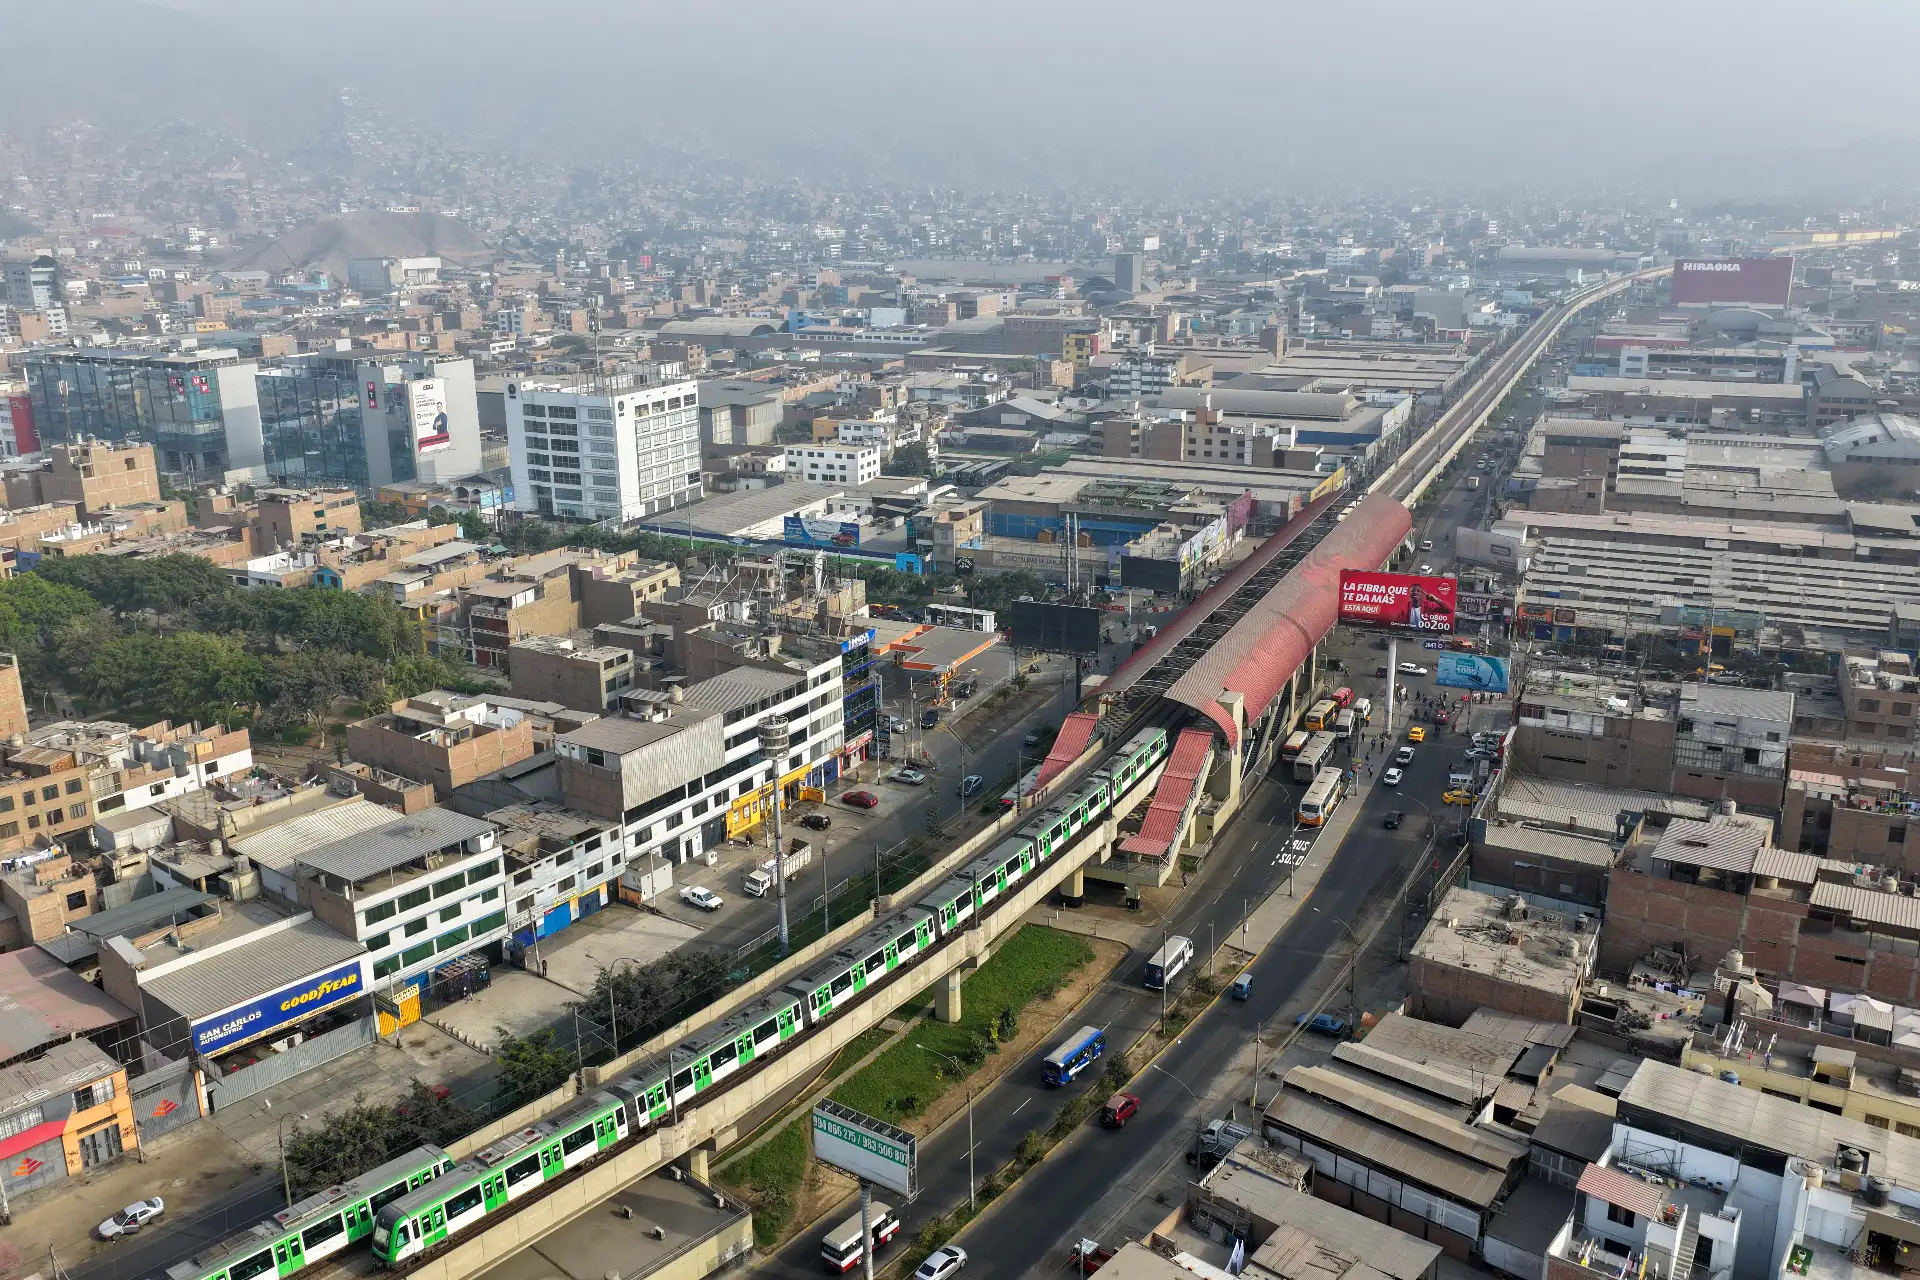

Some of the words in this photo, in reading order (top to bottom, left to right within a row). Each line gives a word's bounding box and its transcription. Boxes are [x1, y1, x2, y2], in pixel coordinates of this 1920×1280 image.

[1682, 262, 1741, 272] HIRAOKA
[1343, 582, 1356, 591] LA
[1357, 583, 1386, 594] FIBRA
[1387, 586, 1408, 596] QUE
[1343, 592, 1354, 601] TE
[1356, 594, 1370, 602] DA
[1371, 594, 1395, 605] MÁS
[1344, 603, 1361, 612] ESTÁ
[1360, 604, 1379, 613] AQUÍ
[1418, 620, 1451, 631] 00200
[1290, 839, 1310, 851] BUS
[280, 974, 357, 1012] GOODYEAR
[199, 1028, 221, 1041] SAN
[222, 1011, 262, 1033] CARLOS
[200, 1024, 244, 1046] AUTOMOTRIZ
[813, 1115, 827, 1131] 994
[827, 1123, 842, 1137] 066
[843, 1129, 856, 1143] 275
[862, 1136, 877, 1152] 983
[878, 1143, 893, 1159] 506
